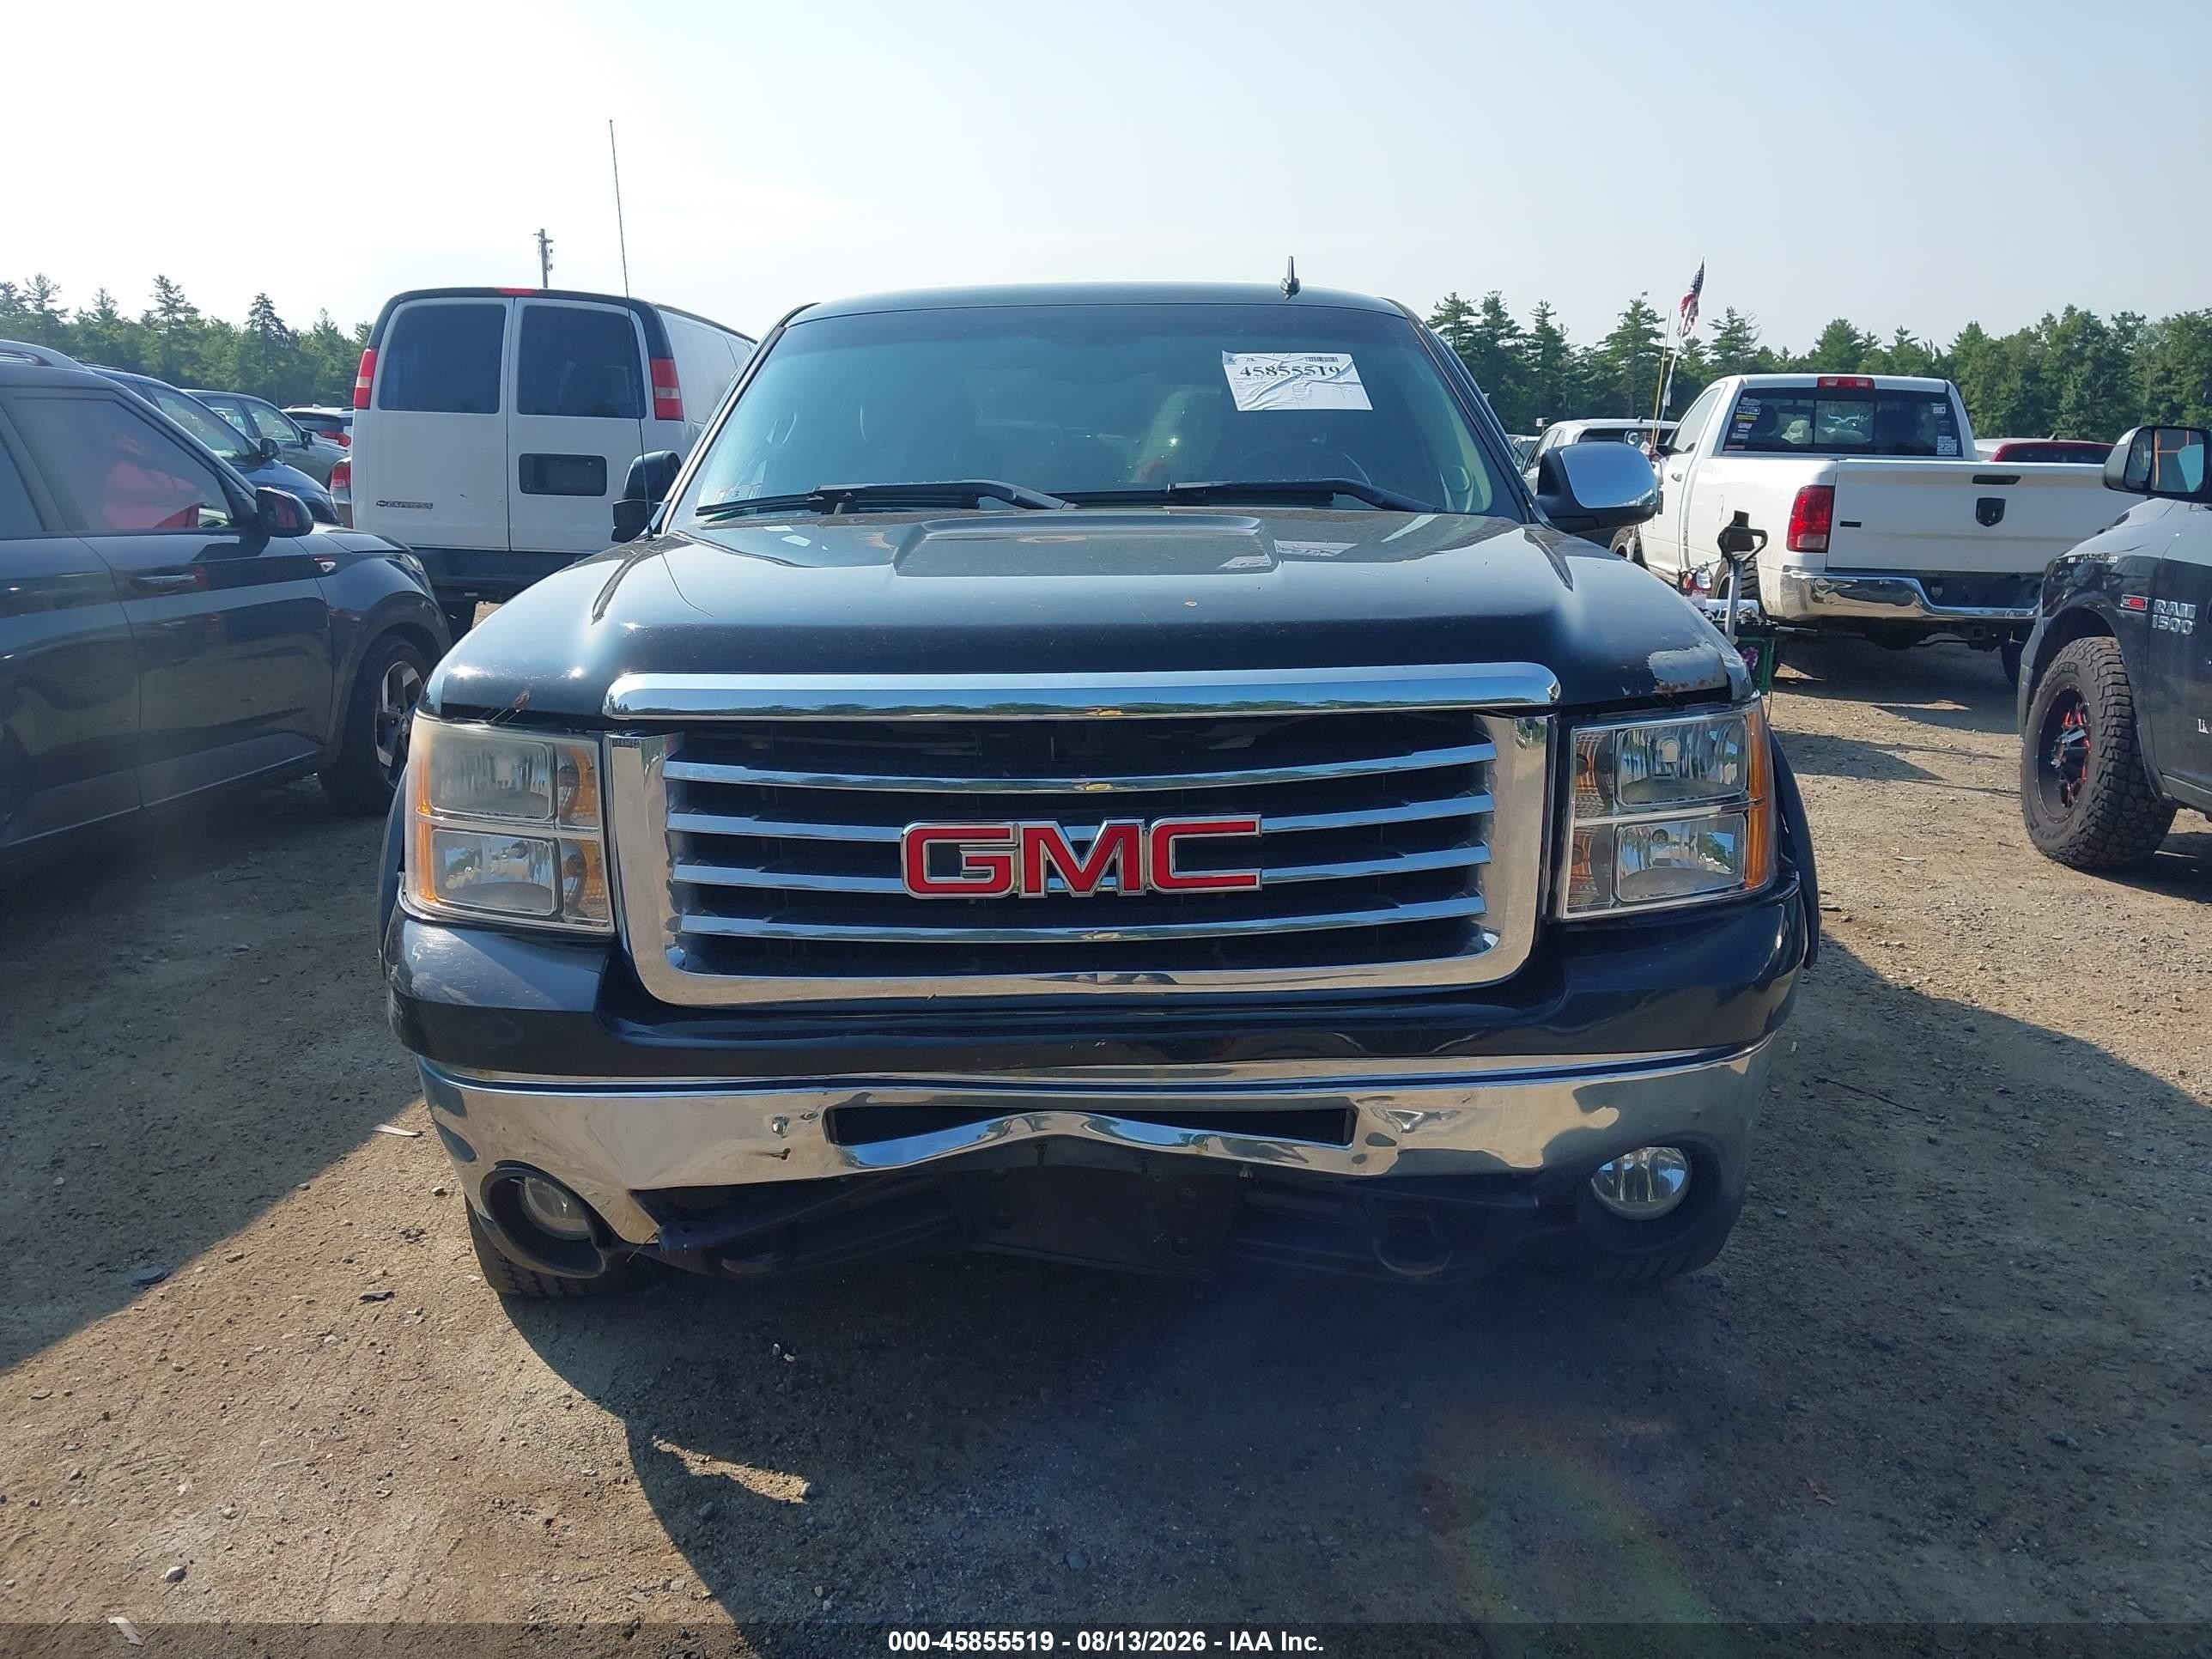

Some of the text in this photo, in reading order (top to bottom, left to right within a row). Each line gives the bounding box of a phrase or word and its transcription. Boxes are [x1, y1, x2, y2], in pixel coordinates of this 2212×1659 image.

[1240, 365, 1341, 377] 45855519
[386, 501, 433, 510] EXPRESS
[2154, 599, 2197, 618] RAM
[2152, 615, 2193, 635] 1500
[902, 814, 1262, 899] GMC
